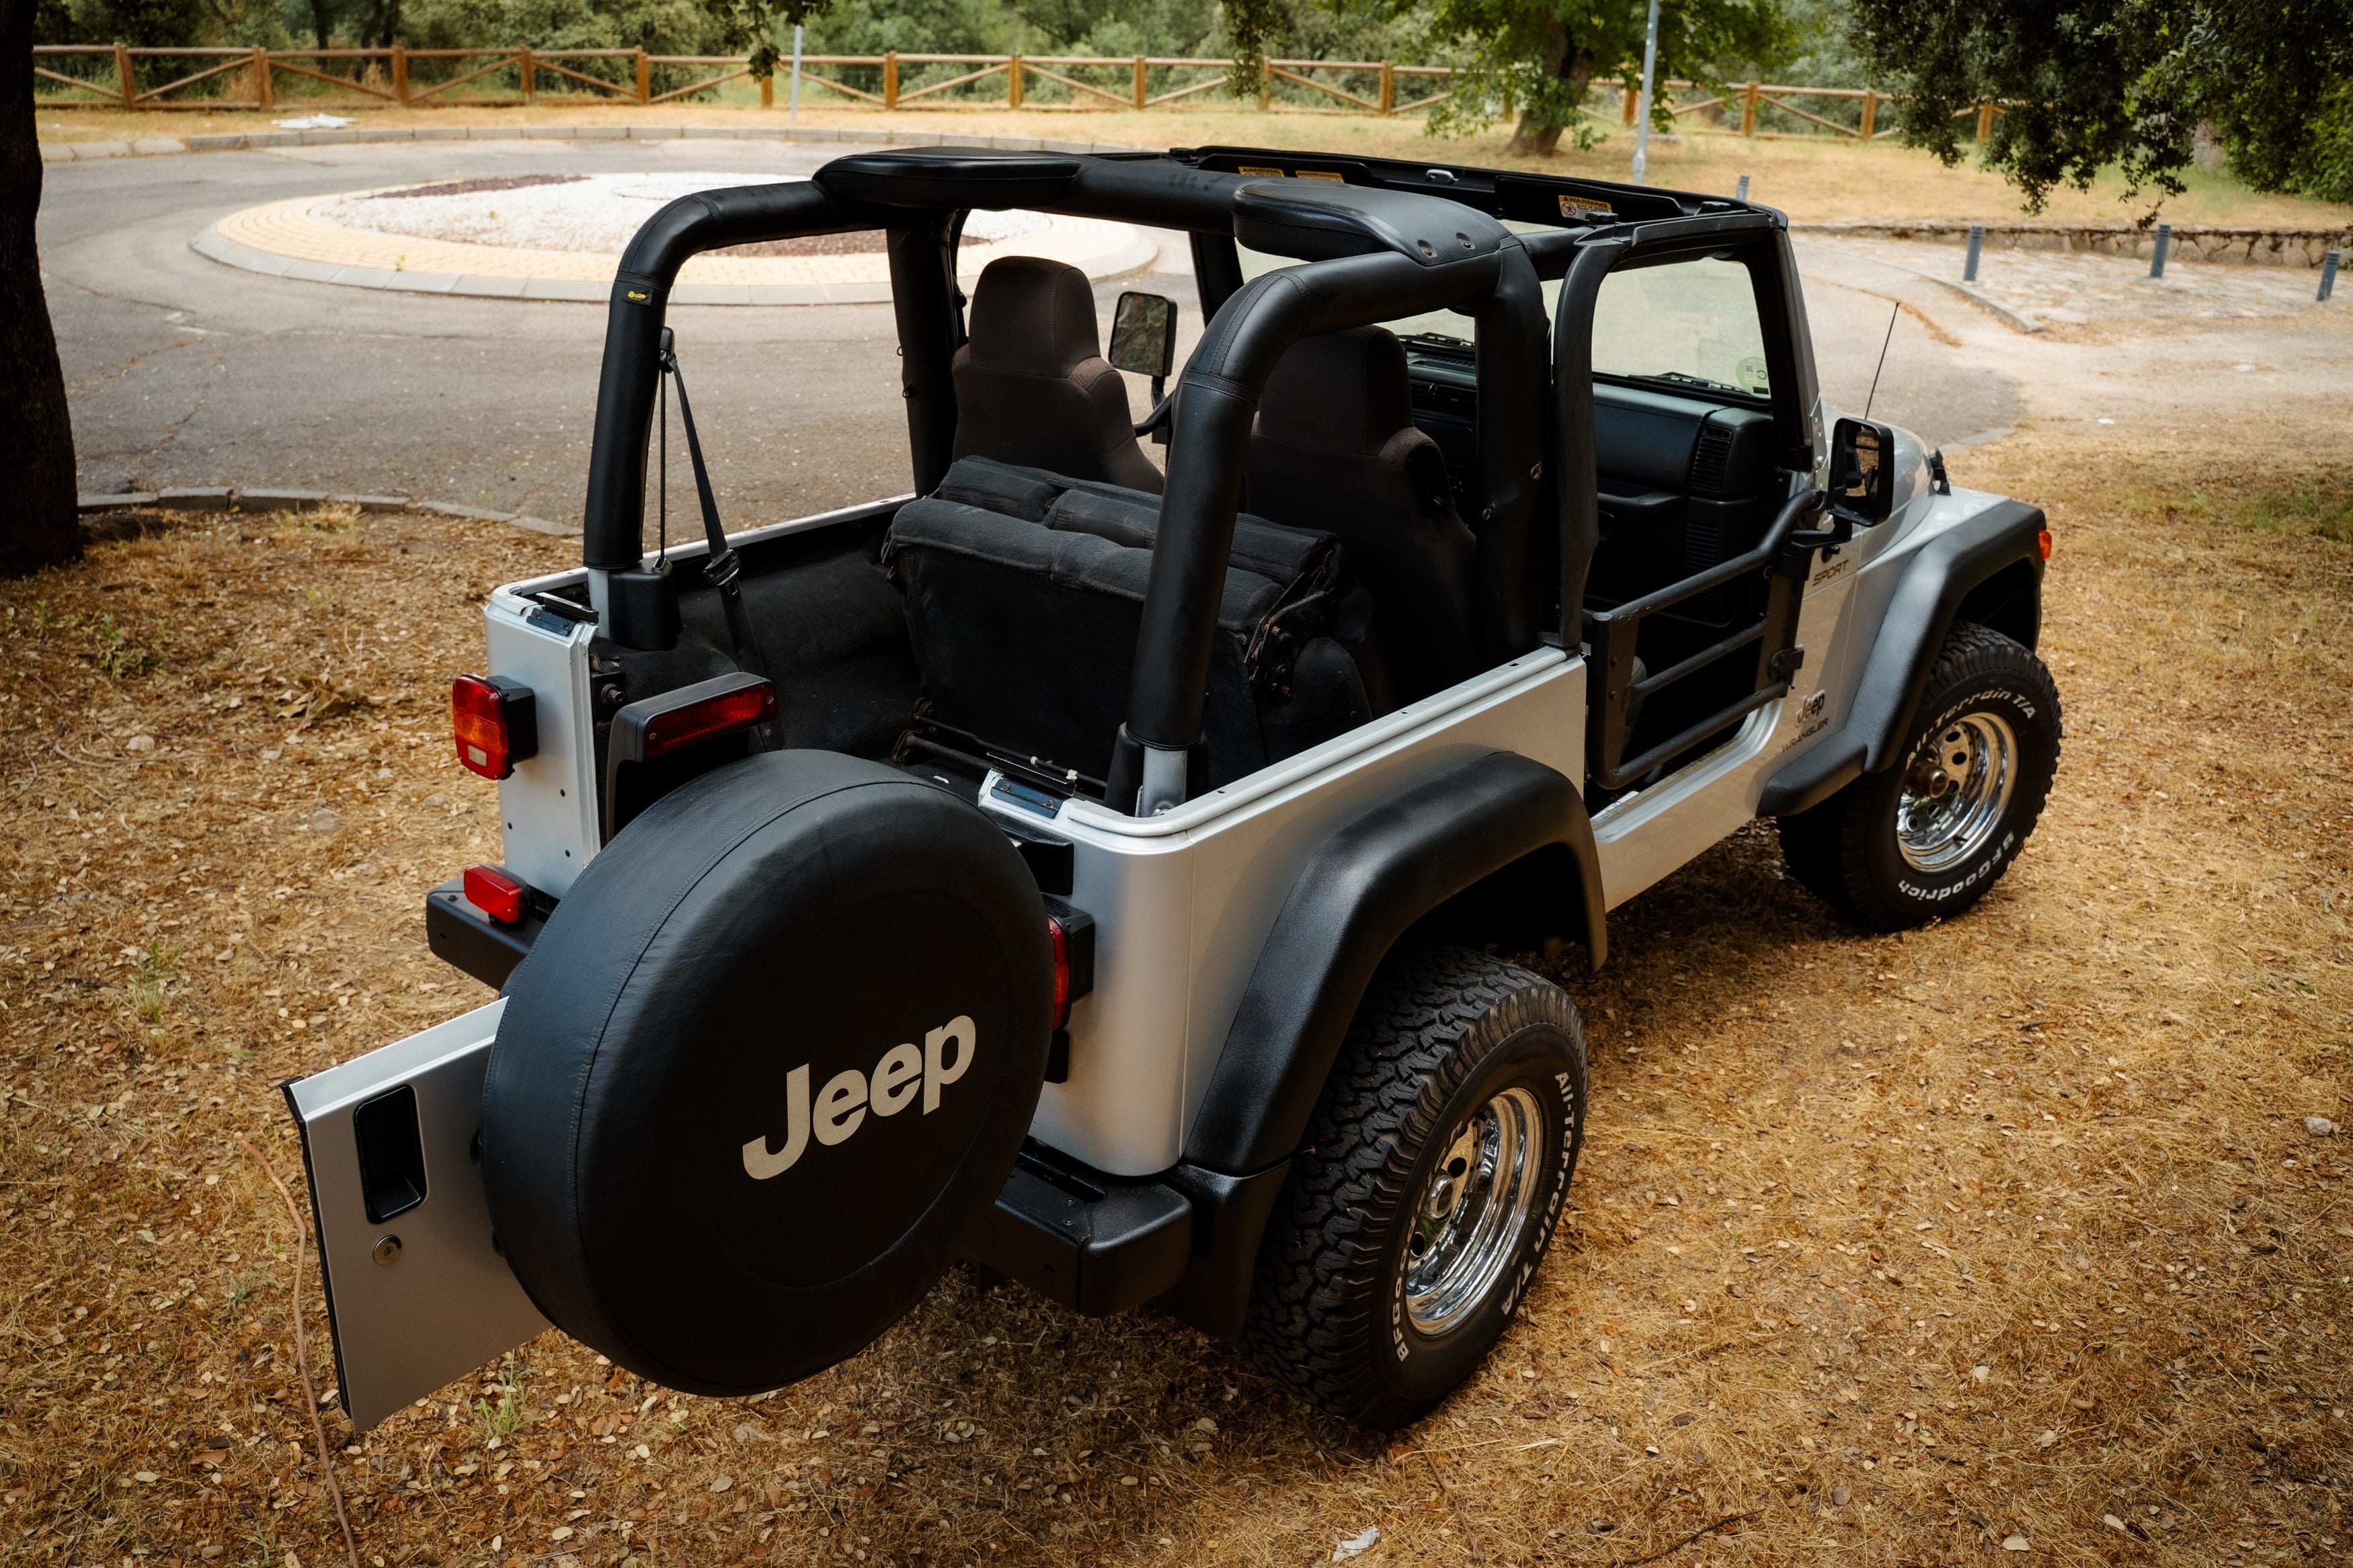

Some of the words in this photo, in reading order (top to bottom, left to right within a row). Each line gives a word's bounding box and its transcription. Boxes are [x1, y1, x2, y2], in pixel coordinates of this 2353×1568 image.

[1568, 197, 1607, 208] WARNING
[1812, 559, 1849, 586] SPORT
[1782, 717, 1829, 752] WRANGLER
[1796, 691, 1825, 725] Jeep
[1906, 688, 2011, 771] All-Terrain
[2012, 694, 2036, 718] T/A
[1898, 831, 2014, 901] BFGoodrich
[742, 1015, 976, 1180] Jeep
[1534, 1072, 1574, 1253] All-Terrain
[1501, 1262, 1533, 1315] T/A
